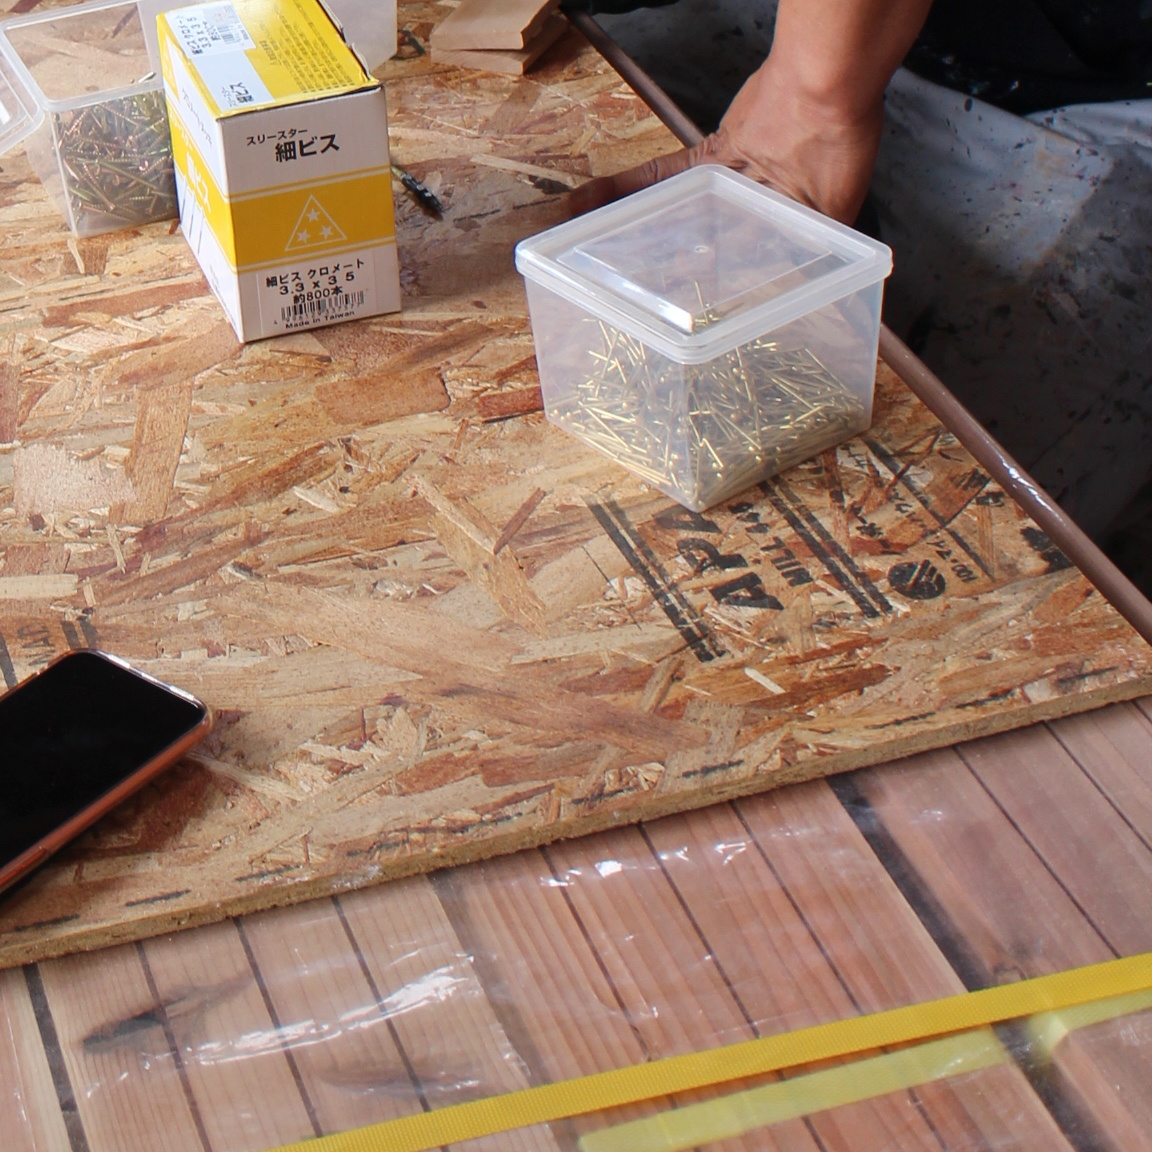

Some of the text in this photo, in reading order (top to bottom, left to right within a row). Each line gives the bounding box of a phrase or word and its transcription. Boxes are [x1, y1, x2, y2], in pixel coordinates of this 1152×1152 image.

[246, 128, 308, 147] スリースター
[274, 133, 341, 163] 細ビス
[265, 258, 365, 289] 細ビス クロメート
[279, 282, 305, 296] 3.3
[293, 285, 343, 305] 約800本
[285, 321, 310, 330] Made
[324, 310, 355, 322] Taiwan
[651, 503, 786, 612] APA
